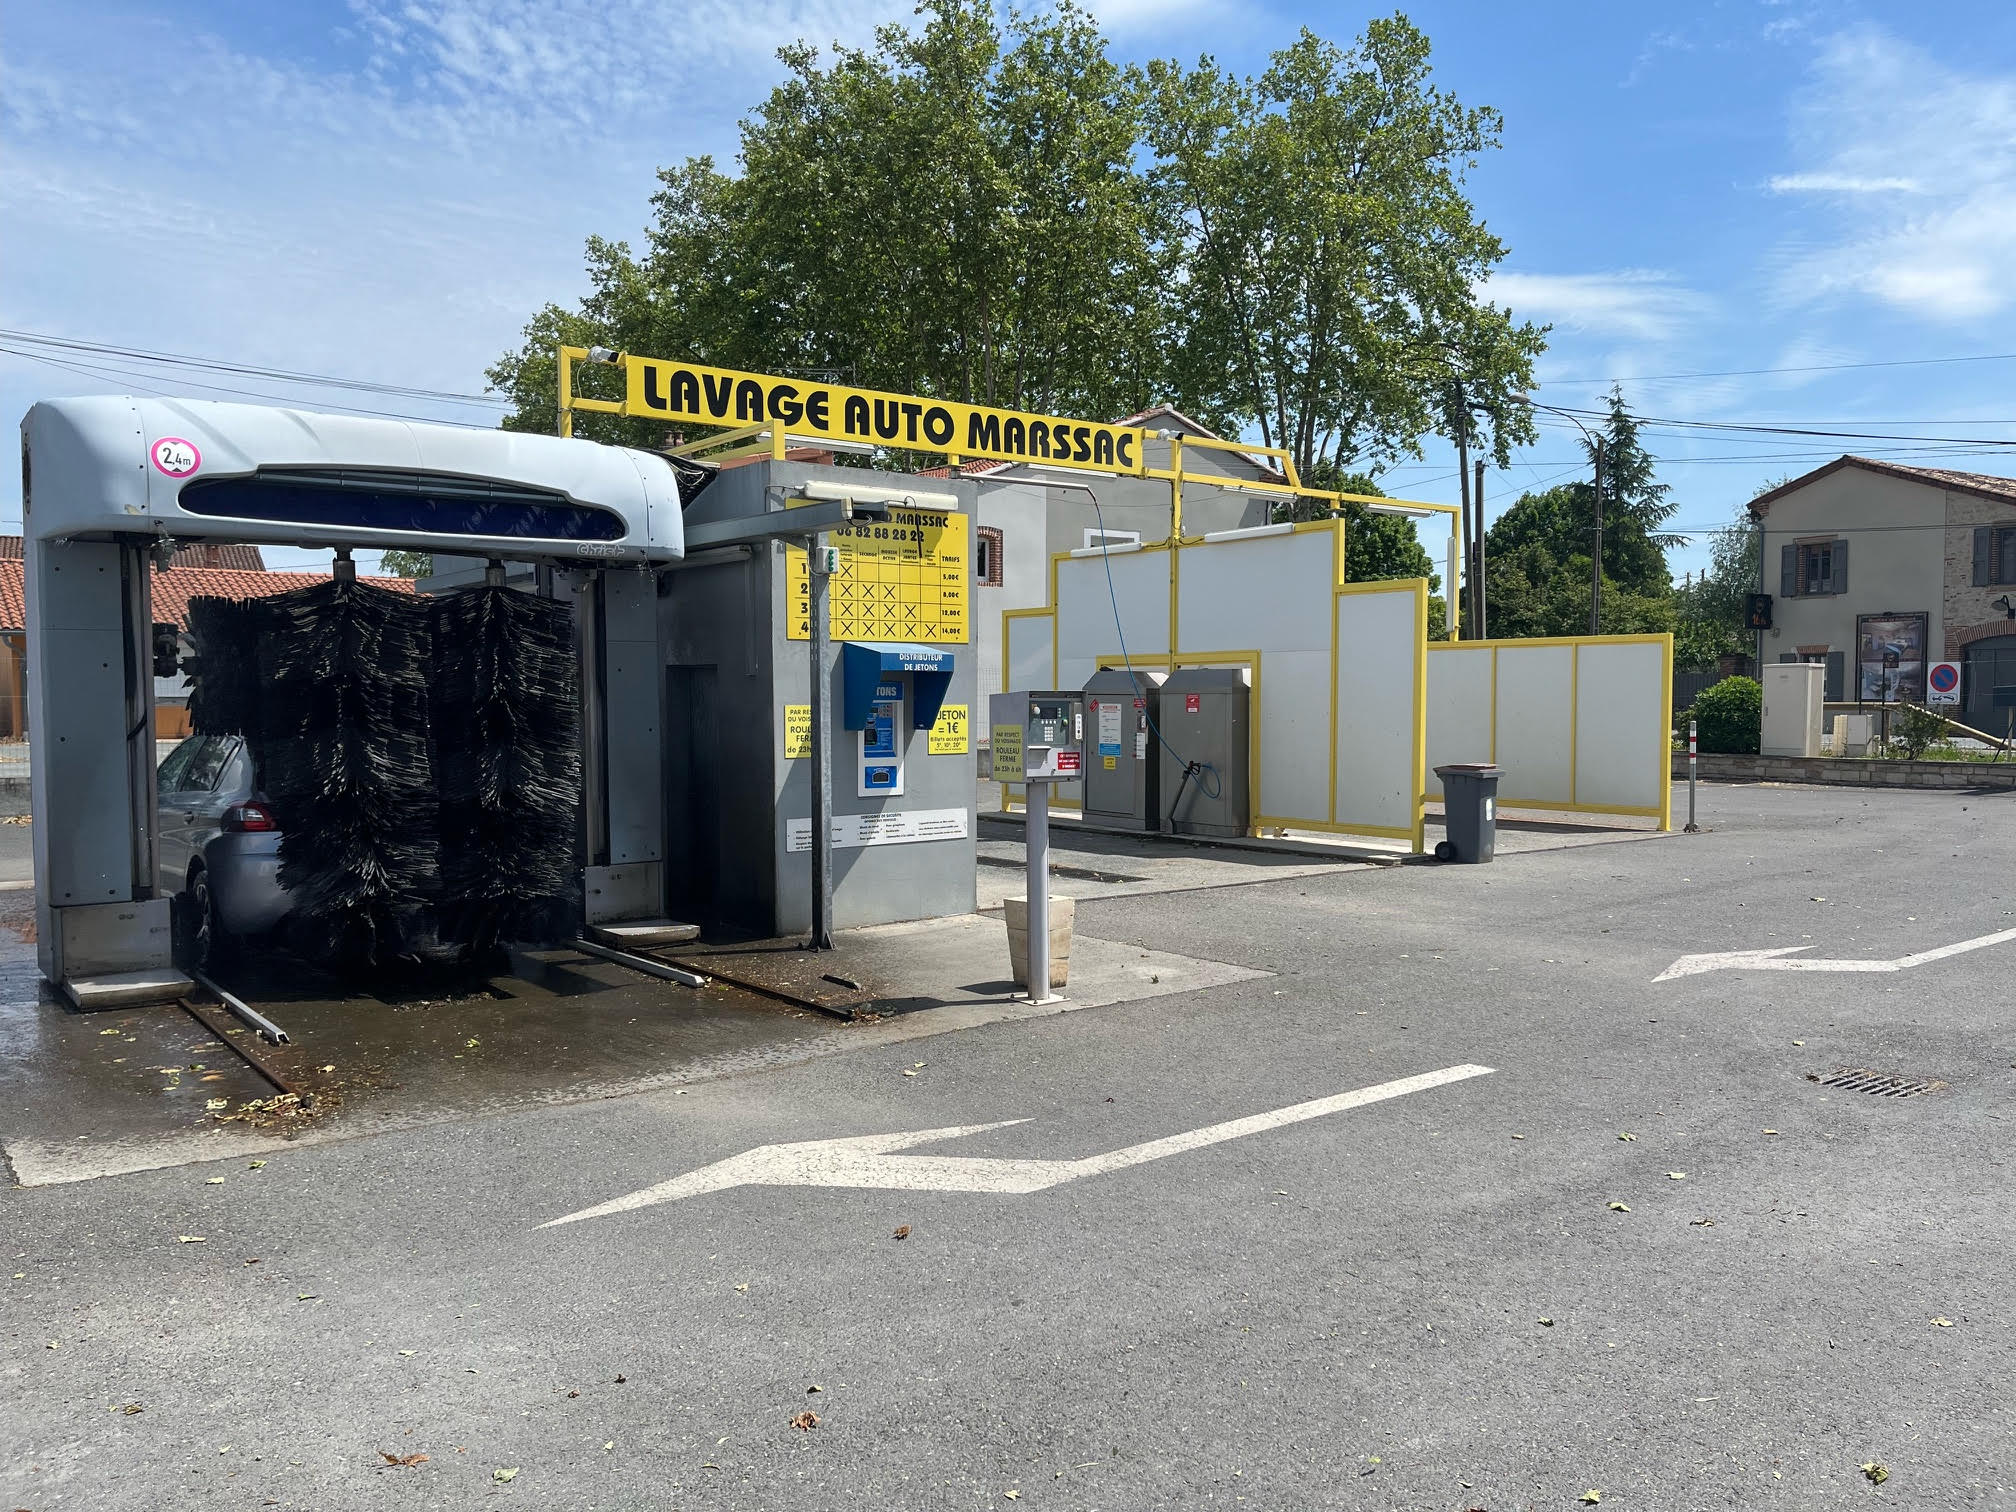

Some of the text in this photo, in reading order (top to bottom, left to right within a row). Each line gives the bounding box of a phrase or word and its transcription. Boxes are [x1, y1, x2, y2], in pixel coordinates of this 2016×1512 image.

[644, 366, 1133, 467] LAVAGE AUTO MARSSAC
[896, 513, 949, 528] MARSSAC
[856, 527, 871, 538] 82
[874, 527, 889, 539] 88
[892, 529, 907, 540] 28
[910, 530, 924, 542] 22
[577, 543, 625, 557] Christ
[801, 563, 807, 574] 1
[801, 583, 808, 594] 2
[801, 602, 808, 613] 3
[801, 621, 809, 632] 4
[900, 653, 942, 661] DISTRIBUTEUR
[914, 663, 938, 671] JETONS
[938, 710, 966, 720] JETON
[946, 721, 959, 734] 1€
